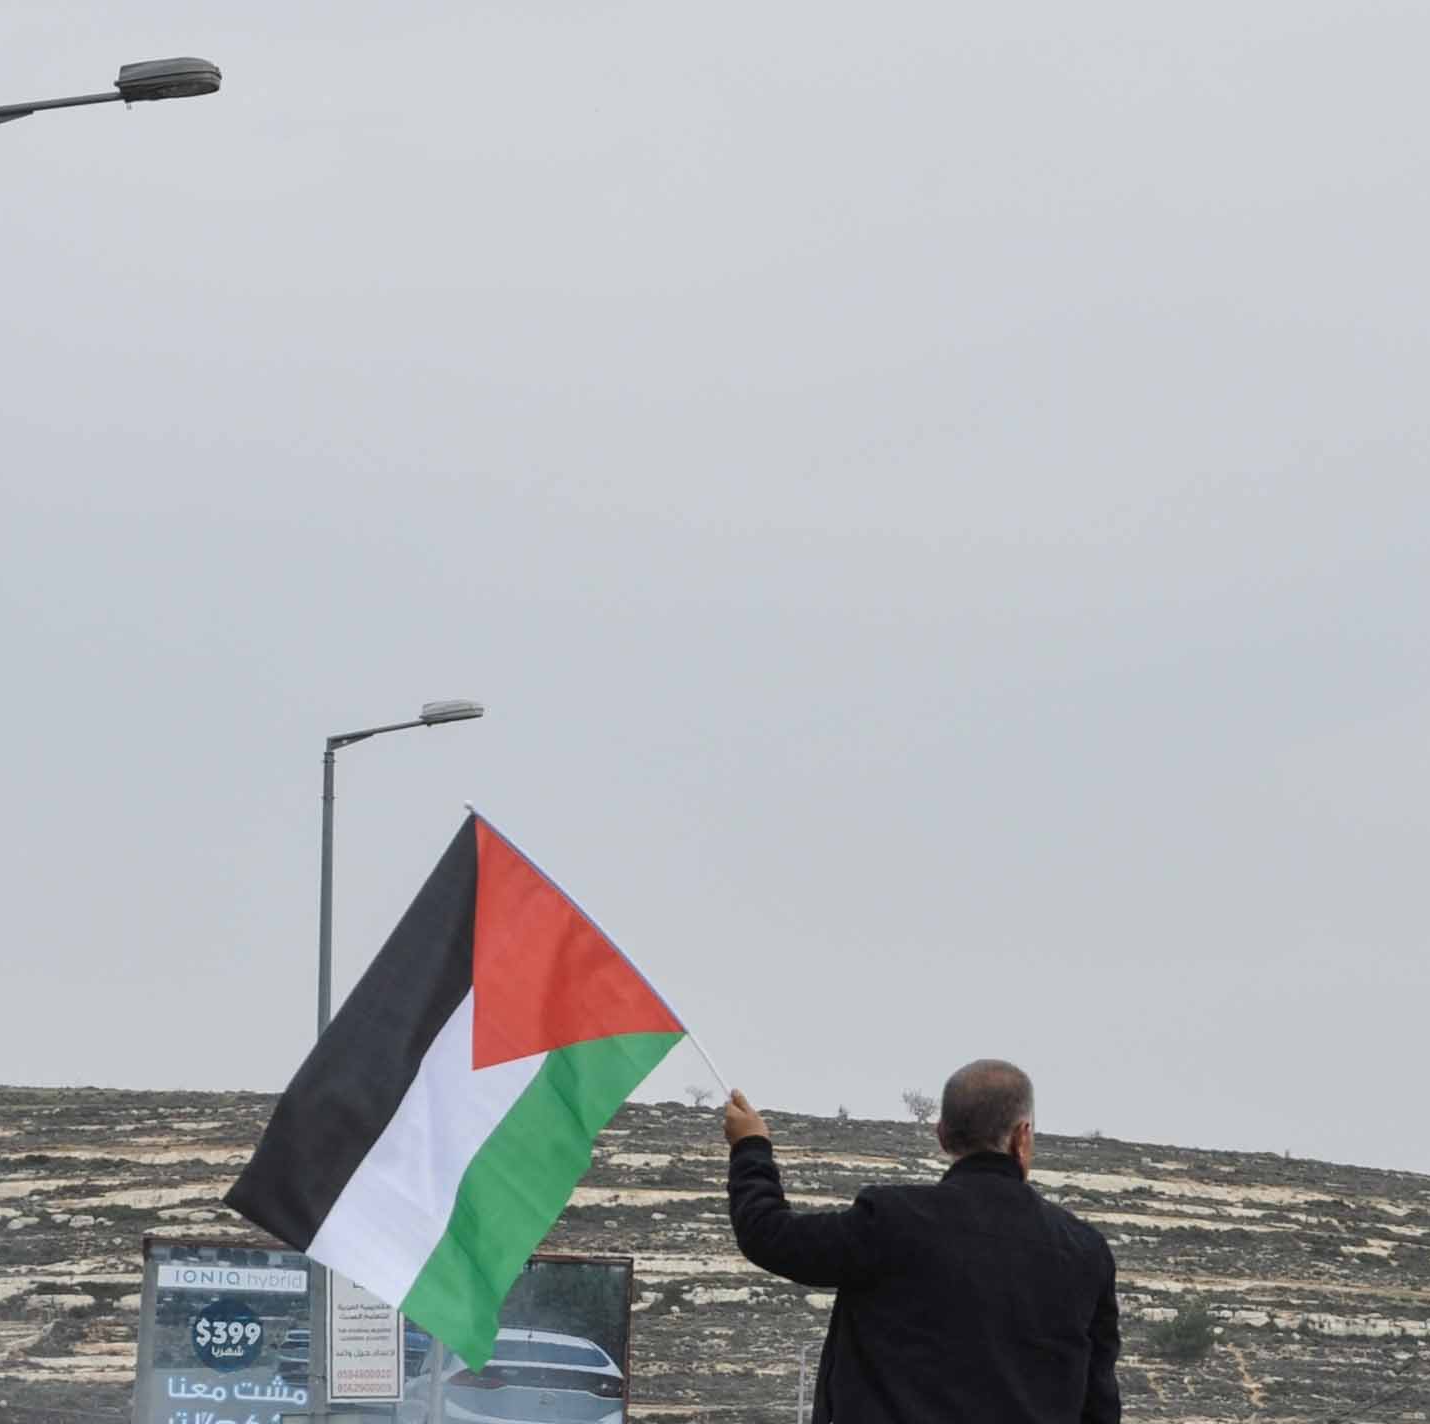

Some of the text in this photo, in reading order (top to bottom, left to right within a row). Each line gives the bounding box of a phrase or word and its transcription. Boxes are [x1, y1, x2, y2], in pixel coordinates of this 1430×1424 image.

[175, 1270, 302, 1289] IONIQ hybrid
[196, 1317, 261, 1346] $399
[168, 1377, 226, 1401] معنا
